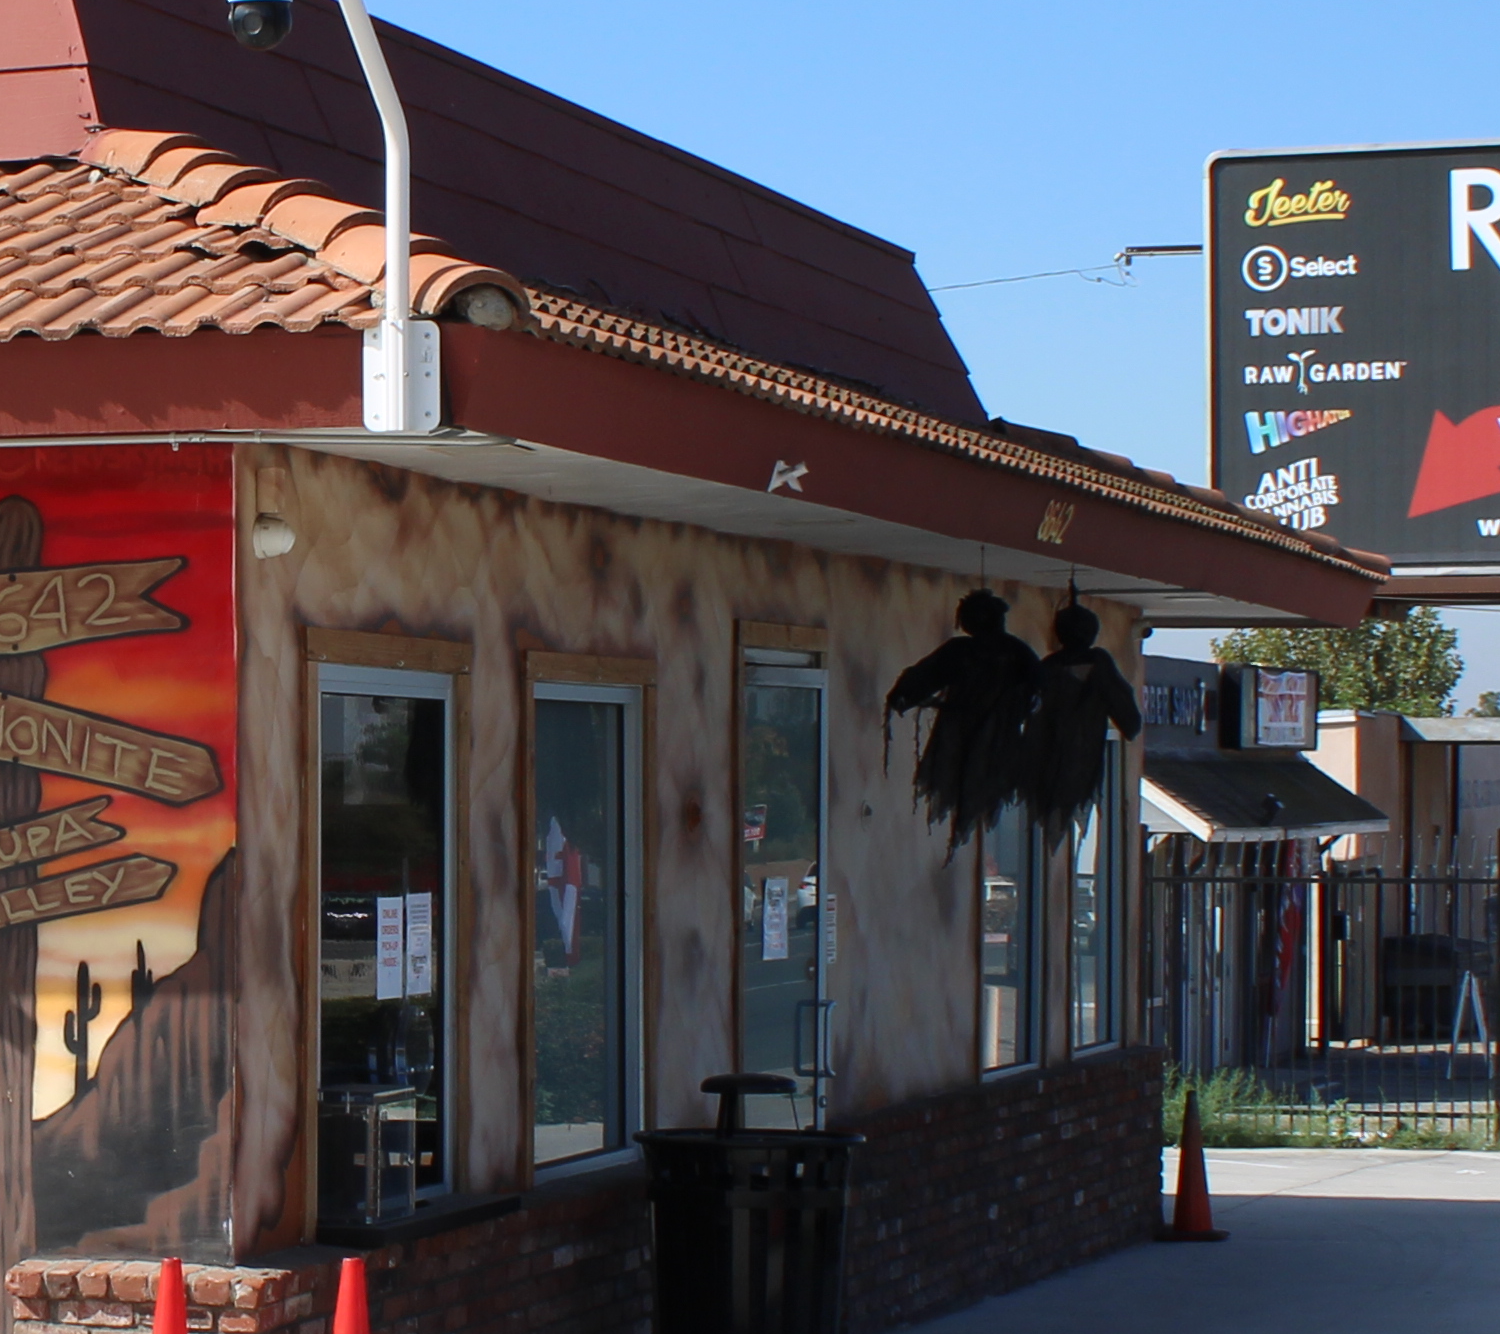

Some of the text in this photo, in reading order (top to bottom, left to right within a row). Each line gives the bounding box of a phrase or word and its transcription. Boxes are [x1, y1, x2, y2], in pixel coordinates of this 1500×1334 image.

[1244, 178, 1351, 227] Jeeter
[1290, 253, 1359, 278] Select
[1244, 306, 1345, 337] TONIK
[1244, 361, 1401, 384] RAW GARDEN
[1256, 457, 1320, 494] ANTI
[1244, 474, 1338, 510] CORPORATE
[1263, 490, 1341, 519] NNABIS
